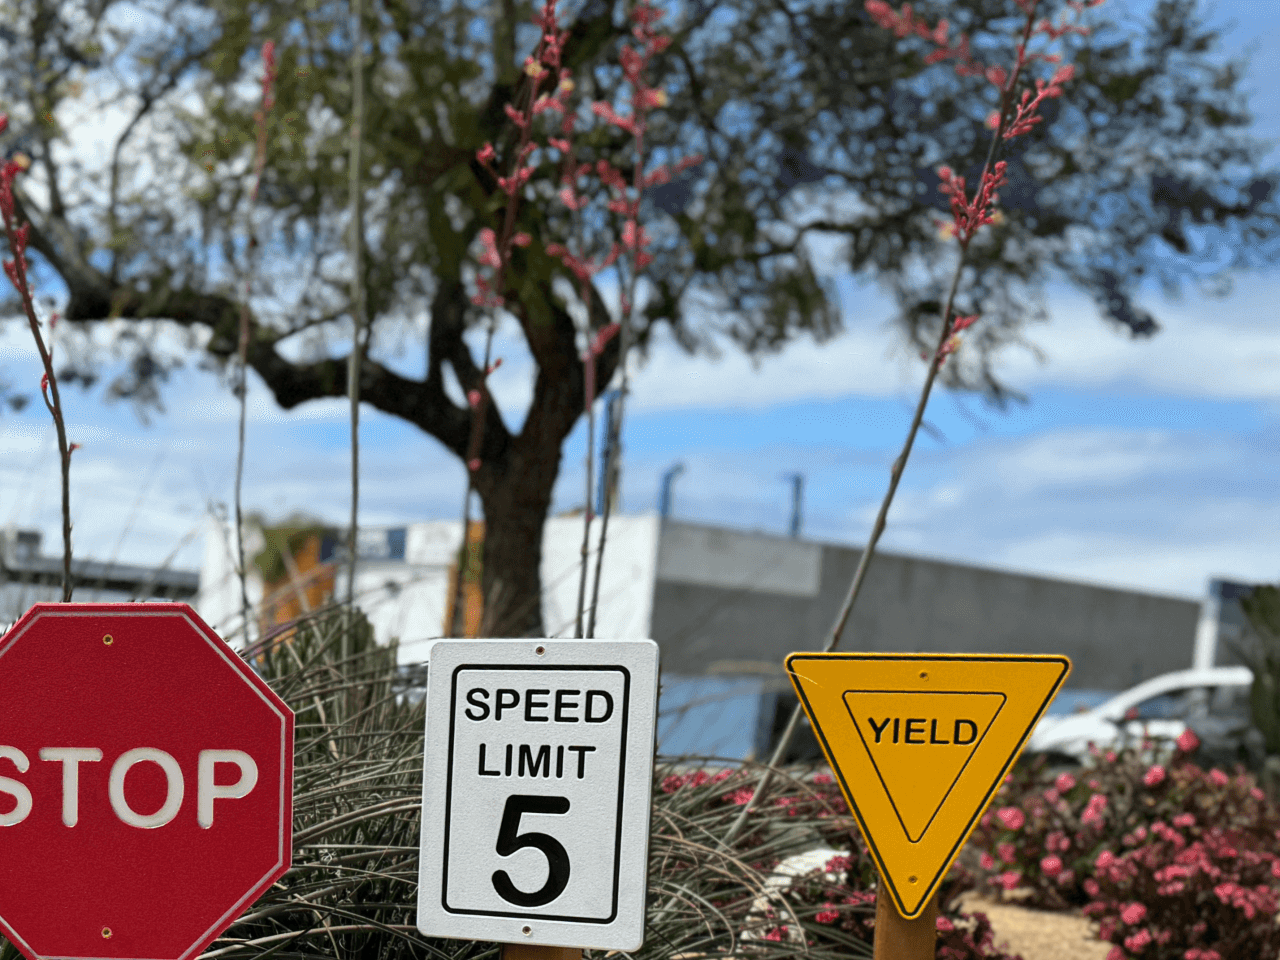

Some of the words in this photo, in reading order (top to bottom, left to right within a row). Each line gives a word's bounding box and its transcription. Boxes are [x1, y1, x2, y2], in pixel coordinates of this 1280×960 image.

[464, 687, 615, 724] SPEED
[867, 716, 979, 746] YIELD
[477, 742, 597, 780] LIMIT
[491, 793, 571, 908] 5
